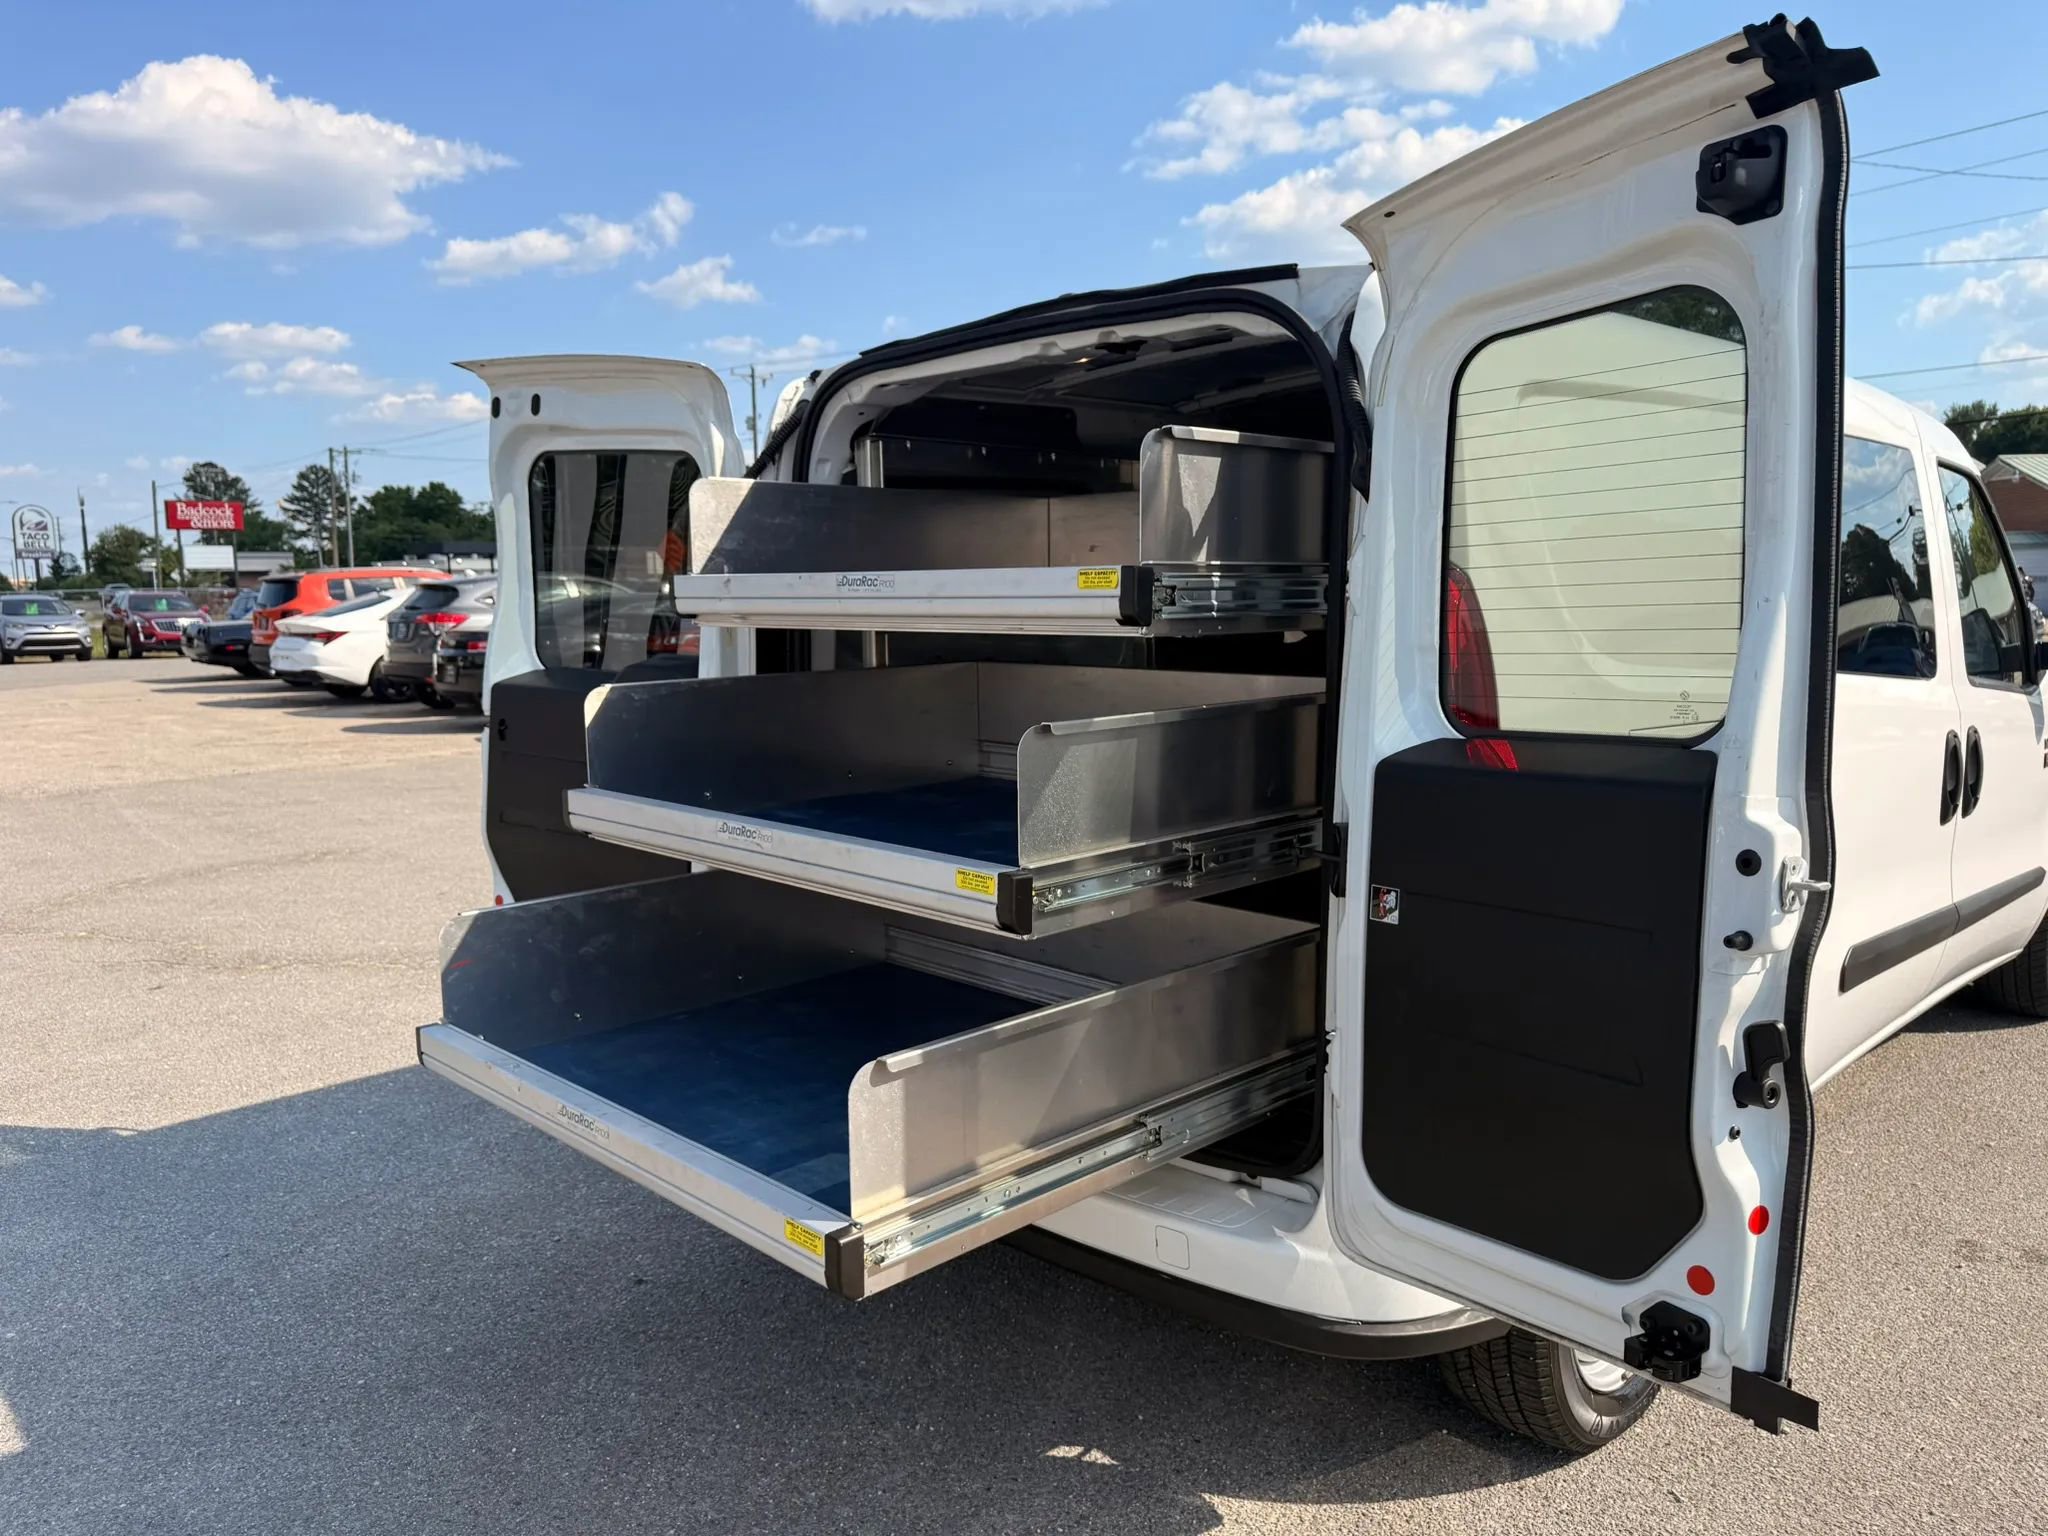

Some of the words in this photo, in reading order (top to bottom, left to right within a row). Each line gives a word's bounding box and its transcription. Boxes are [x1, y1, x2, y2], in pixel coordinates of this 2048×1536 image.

[176, 502, 234, 515] Badcock
[20, 532, 50, 541] TACO
[23, 541, 50, 550] BELL
[841, 575, 879, 588] DuraRac
[971, 872, 993, 881] CAPACITY
